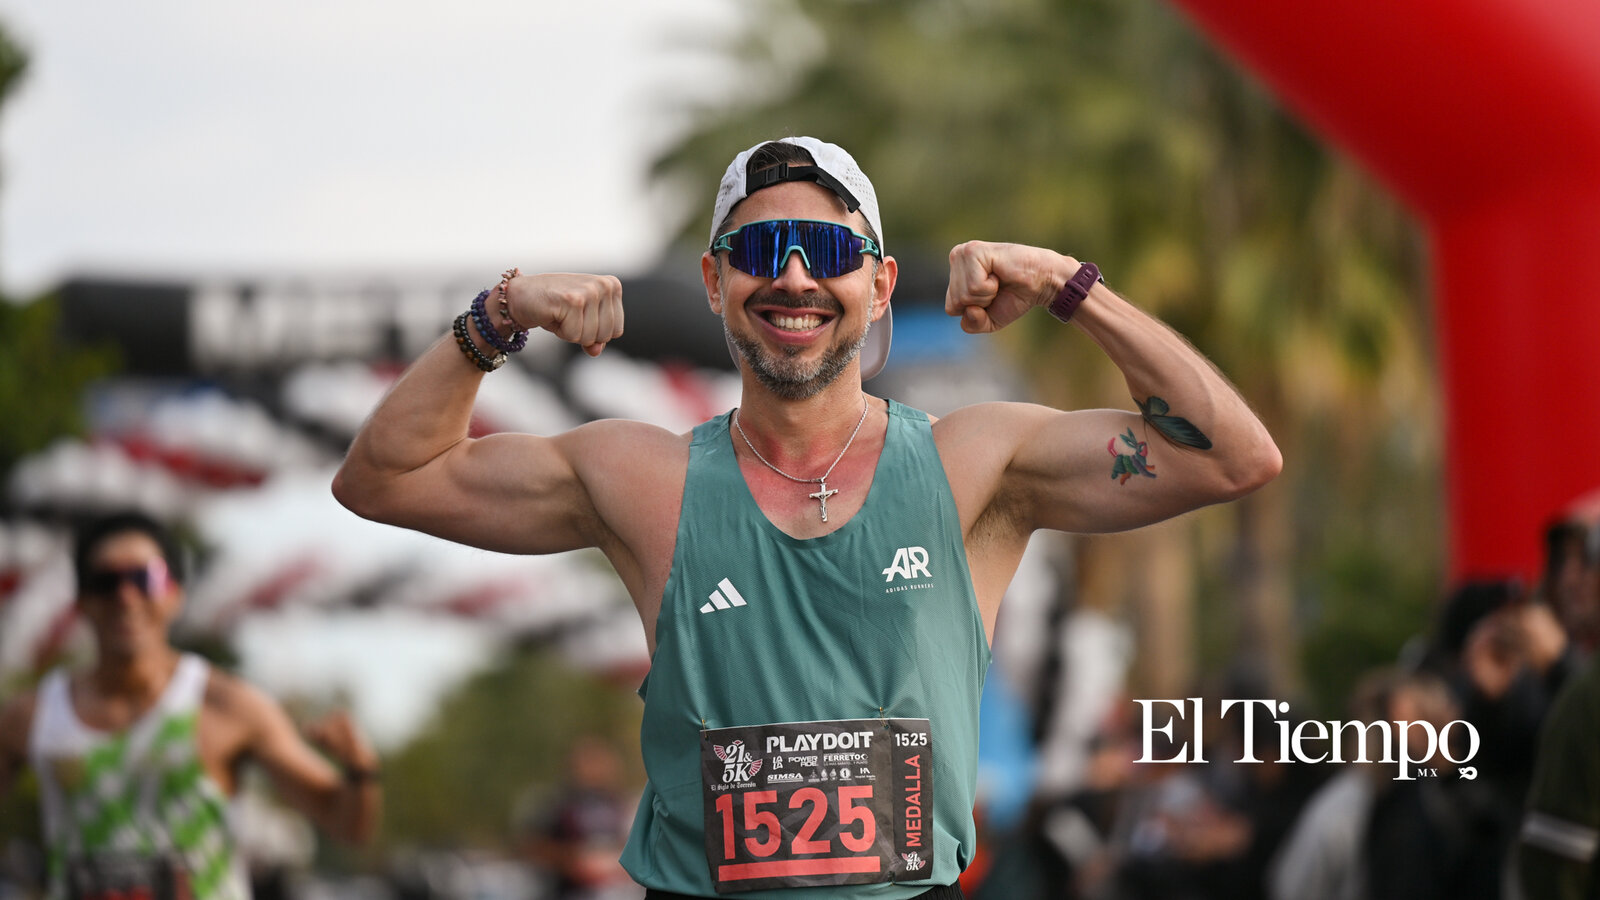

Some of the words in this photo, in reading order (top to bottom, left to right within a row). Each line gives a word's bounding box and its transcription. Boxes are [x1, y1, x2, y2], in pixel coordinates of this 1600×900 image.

[885, 585, 908, 593] ADIDAS
[766, 731, 874, 753] PLAYDOIT
[895, 733, 928, 747] 1525
[722, 763, 752, 783] 5K
[767, 772, 804, 781] SIMSA
[904, 754, 922, 847] MEDALLA
[715, 785, 876, 860] 1525
